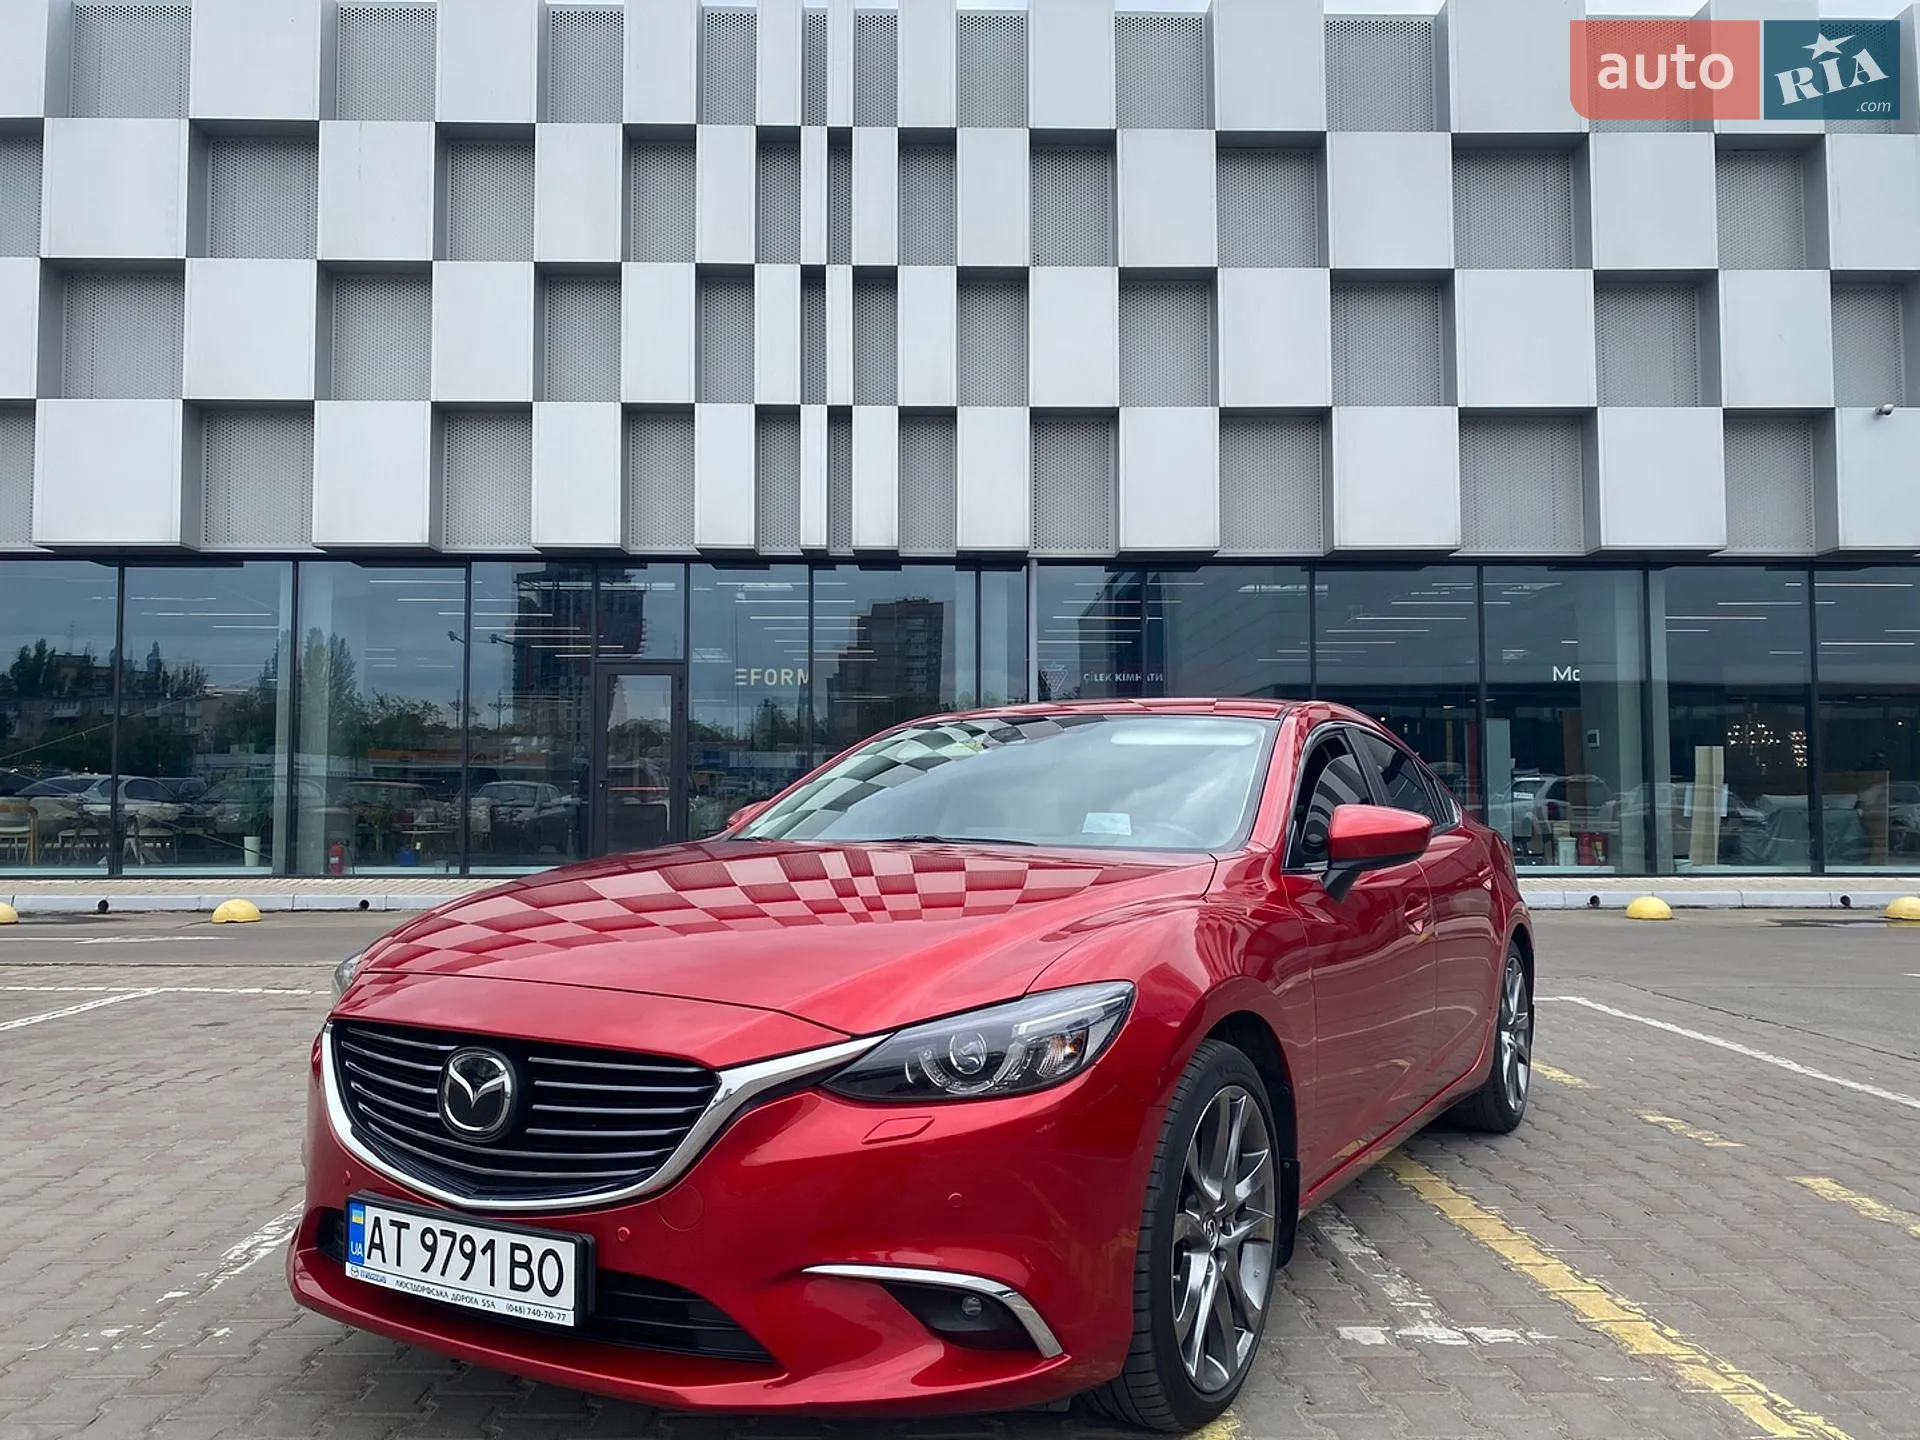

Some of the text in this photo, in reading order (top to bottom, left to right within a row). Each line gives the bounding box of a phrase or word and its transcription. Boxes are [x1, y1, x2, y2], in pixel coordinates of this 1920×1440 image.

[350, 1240, 364, 1256] UA
[366, 1216, 565, 1298] AT 9791 BO
